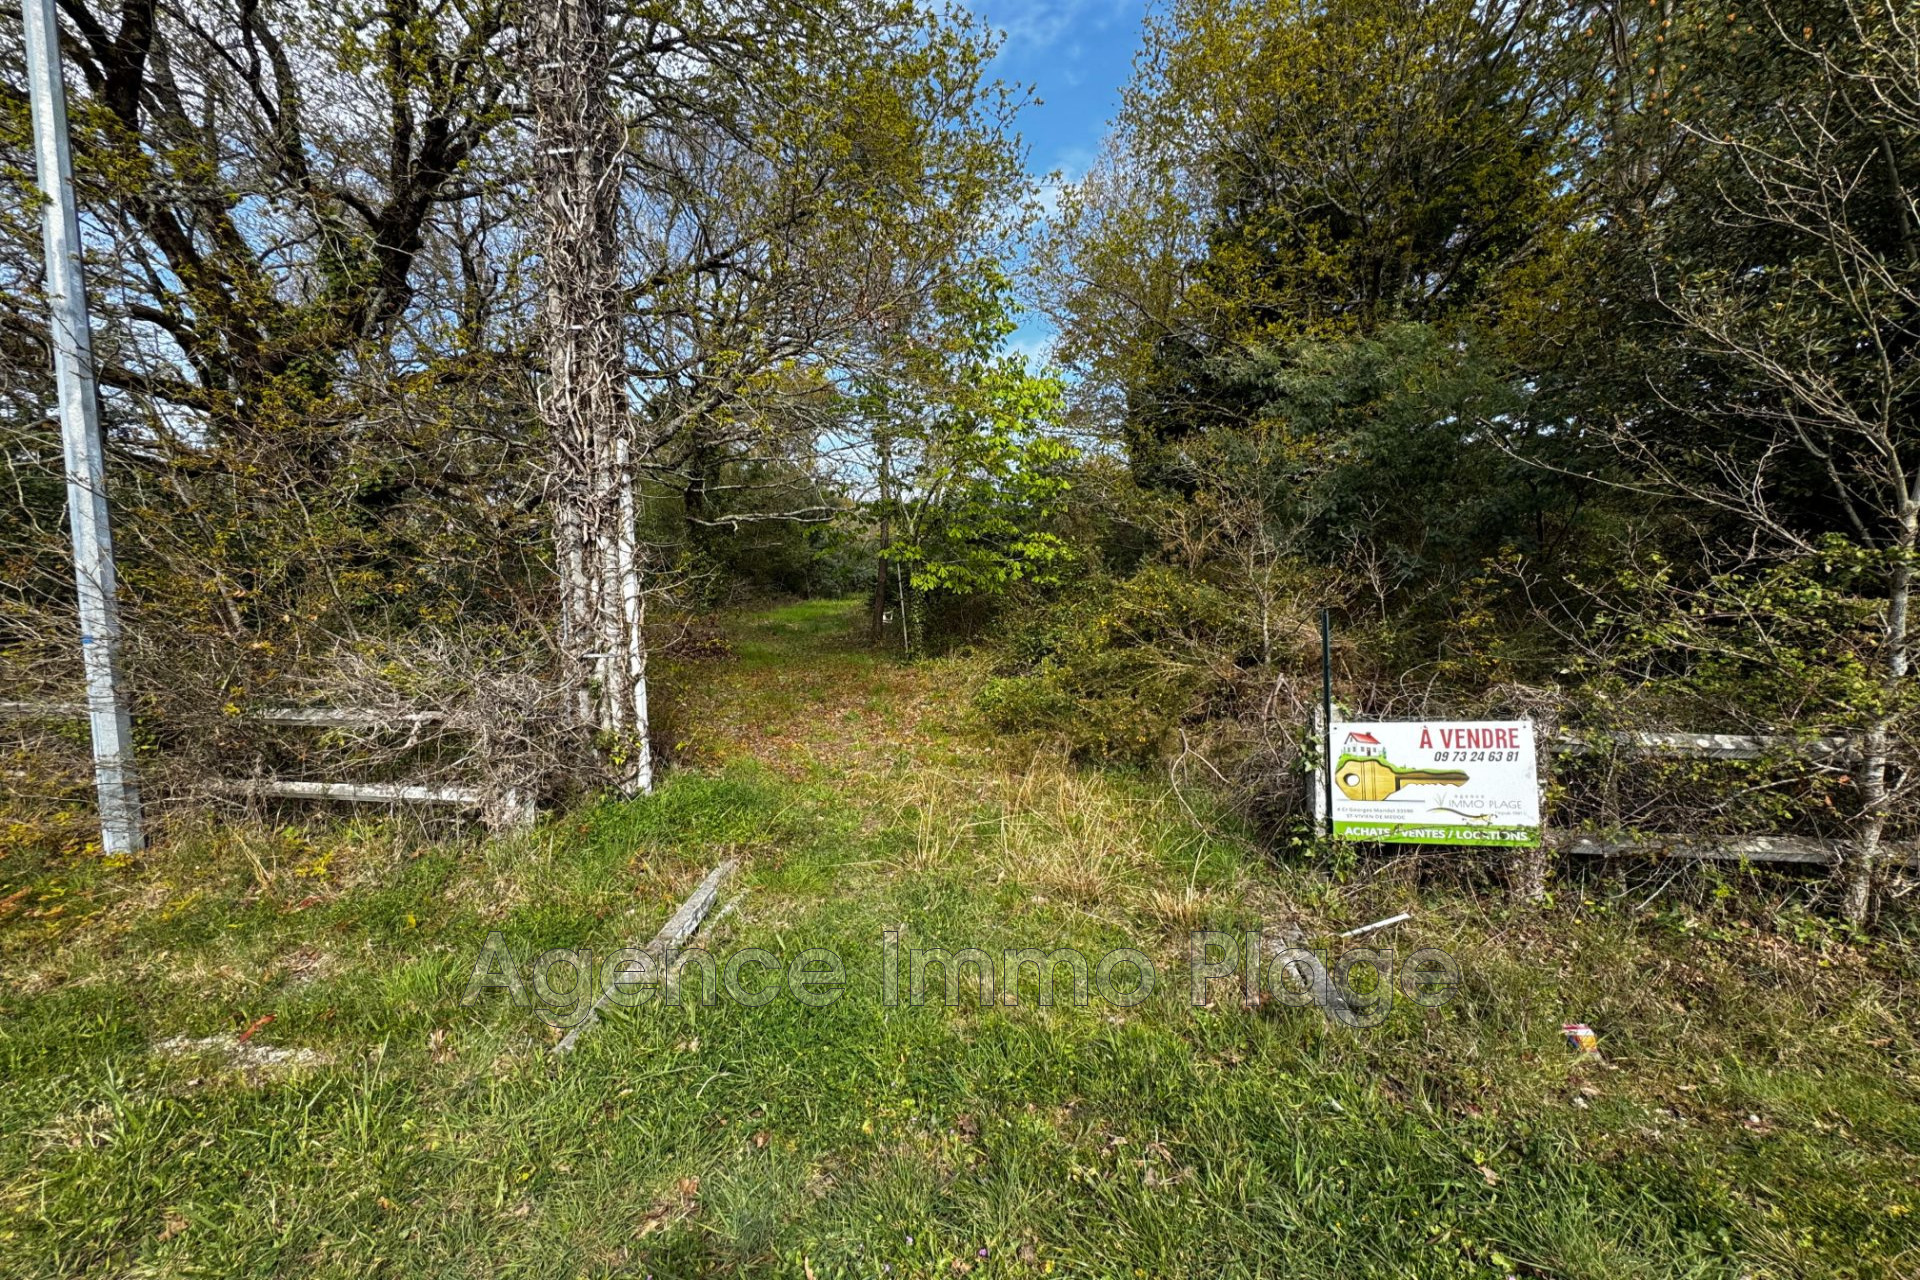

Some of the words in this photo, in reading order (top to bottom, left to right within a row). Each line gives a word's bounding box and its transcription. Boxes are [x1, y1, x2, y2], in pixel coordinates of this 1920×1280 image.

[1419, 725, 1433, 749] À
[1439, 728, 1520, 749] VENDRE
[1434, 751, 1449, 762] 09
[1452, 751, 1467, 762] 73
[1470, 751, 1485, 762] 24
[1488, 751, 1503, 762] 63
[1506, 751, 1519, 762] 81
[1449, 800, 1485, 809] IMMO
[1489, 800, 1522, 810] PLAGE
[1344, 826, 1391, 837] ACHATS
[1402, 828, 1446, 839] VENTES
[1456, 830, 1529, 841] LOCATIONS
